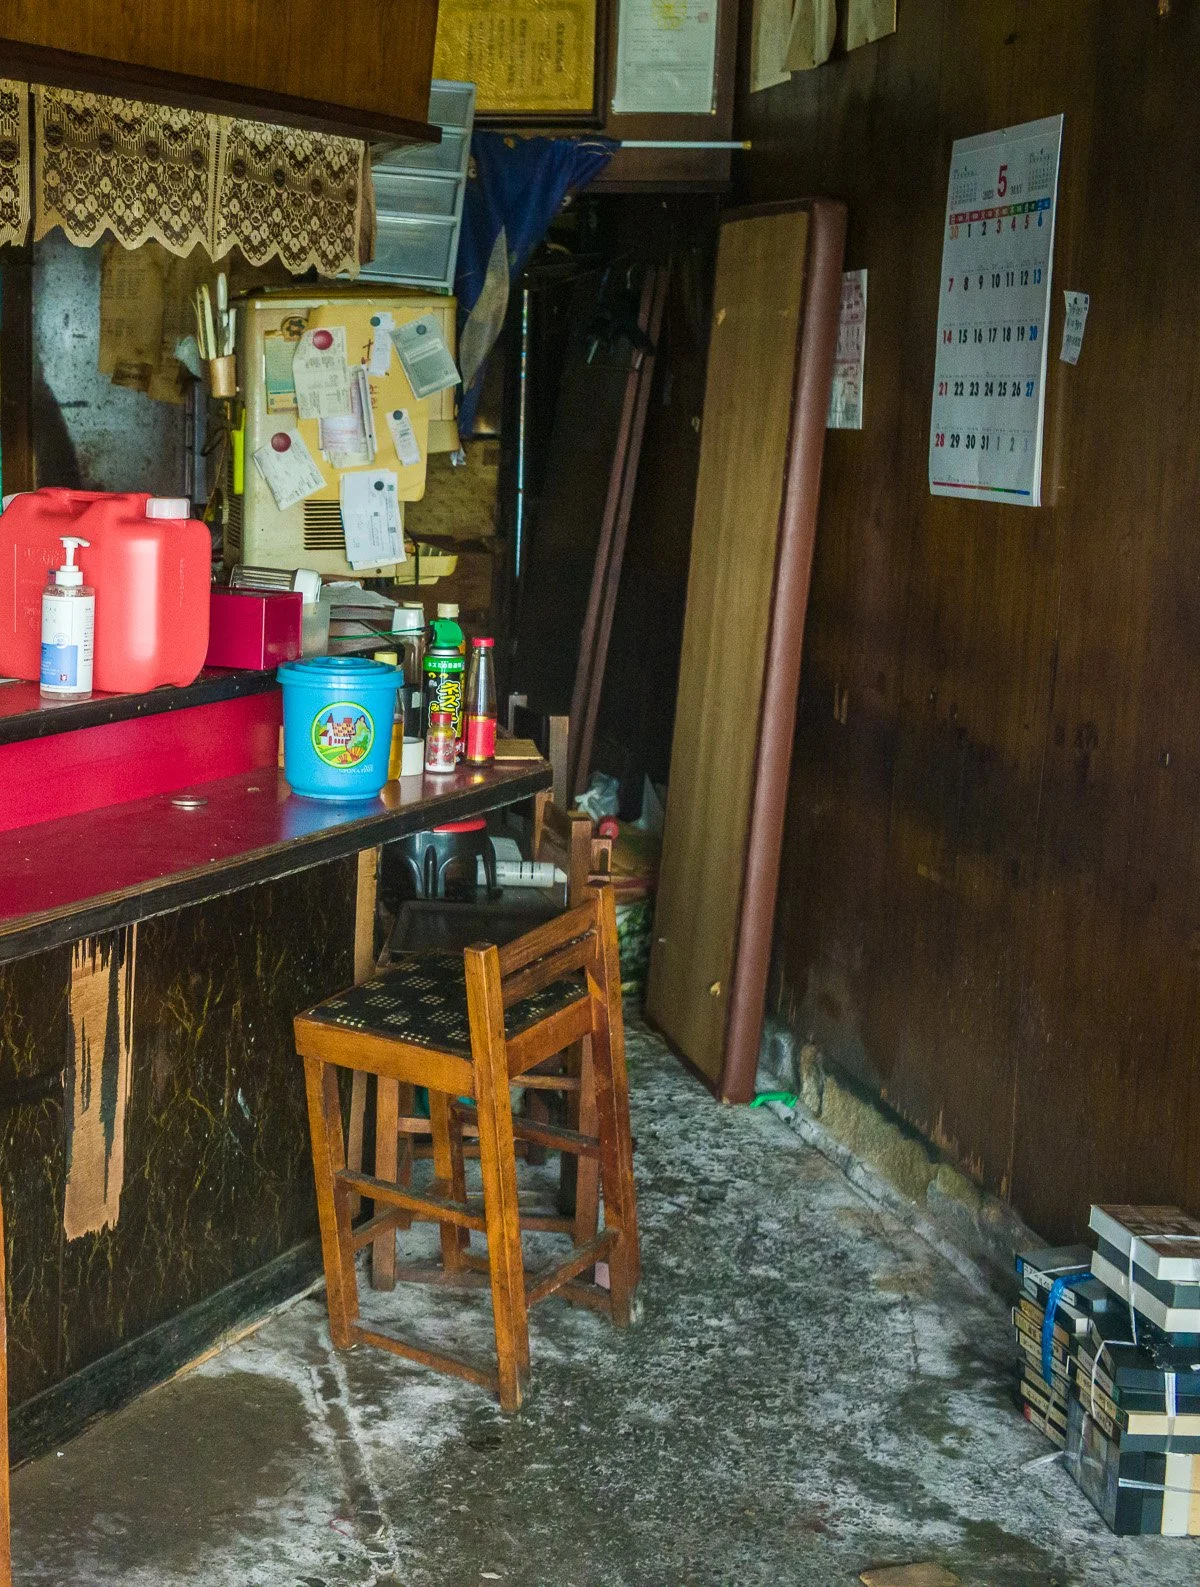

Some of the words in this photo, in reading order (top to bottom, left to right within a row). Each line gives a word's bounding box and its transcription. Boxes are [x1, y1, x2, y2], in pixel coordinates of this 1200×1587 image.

[997, 164, 1008, 197] 5
[967, 223, 972, 237] 1
[982, 221, 987, 236] 2
[1011, 216, 1017, 231] 4
[948, 277, 954, 292] 7
[963, 276, 969, 291] 8
[978, 275, 984, 290] 9
[991, 273, 1000, 289] 10
[1006, 271, 1014, 288] 11
[1020, 270, 1029, 286] 12
[1033, 268, 1042, 285] 13
[943, 329, 952, 344] 14
[958, 328, 968, 344] 15
[974, 328, 983, 344] 16
[988, 327, 998, 343] 17
[1002, 326, 1011, 342] 18
[1017, 325, 1025, 341] 19
[1029, 325, 1038, 341] 20
[939, 382, 948, 396] 21
[954, 381, 964, 396] 22
[969, 381, 979, 397] 23
[984, 381, 994, 397] 24
[998, 381, 1007, 397] 25
[1011, 381, 1021, 397] 26
[1025, 381, 1034, 398] 27
[935, 432, 945, 447] 28
[950, 433, 960, 449] 29
[965, 434, 975, 449] 30
[981, 435, 989, 451] 31
